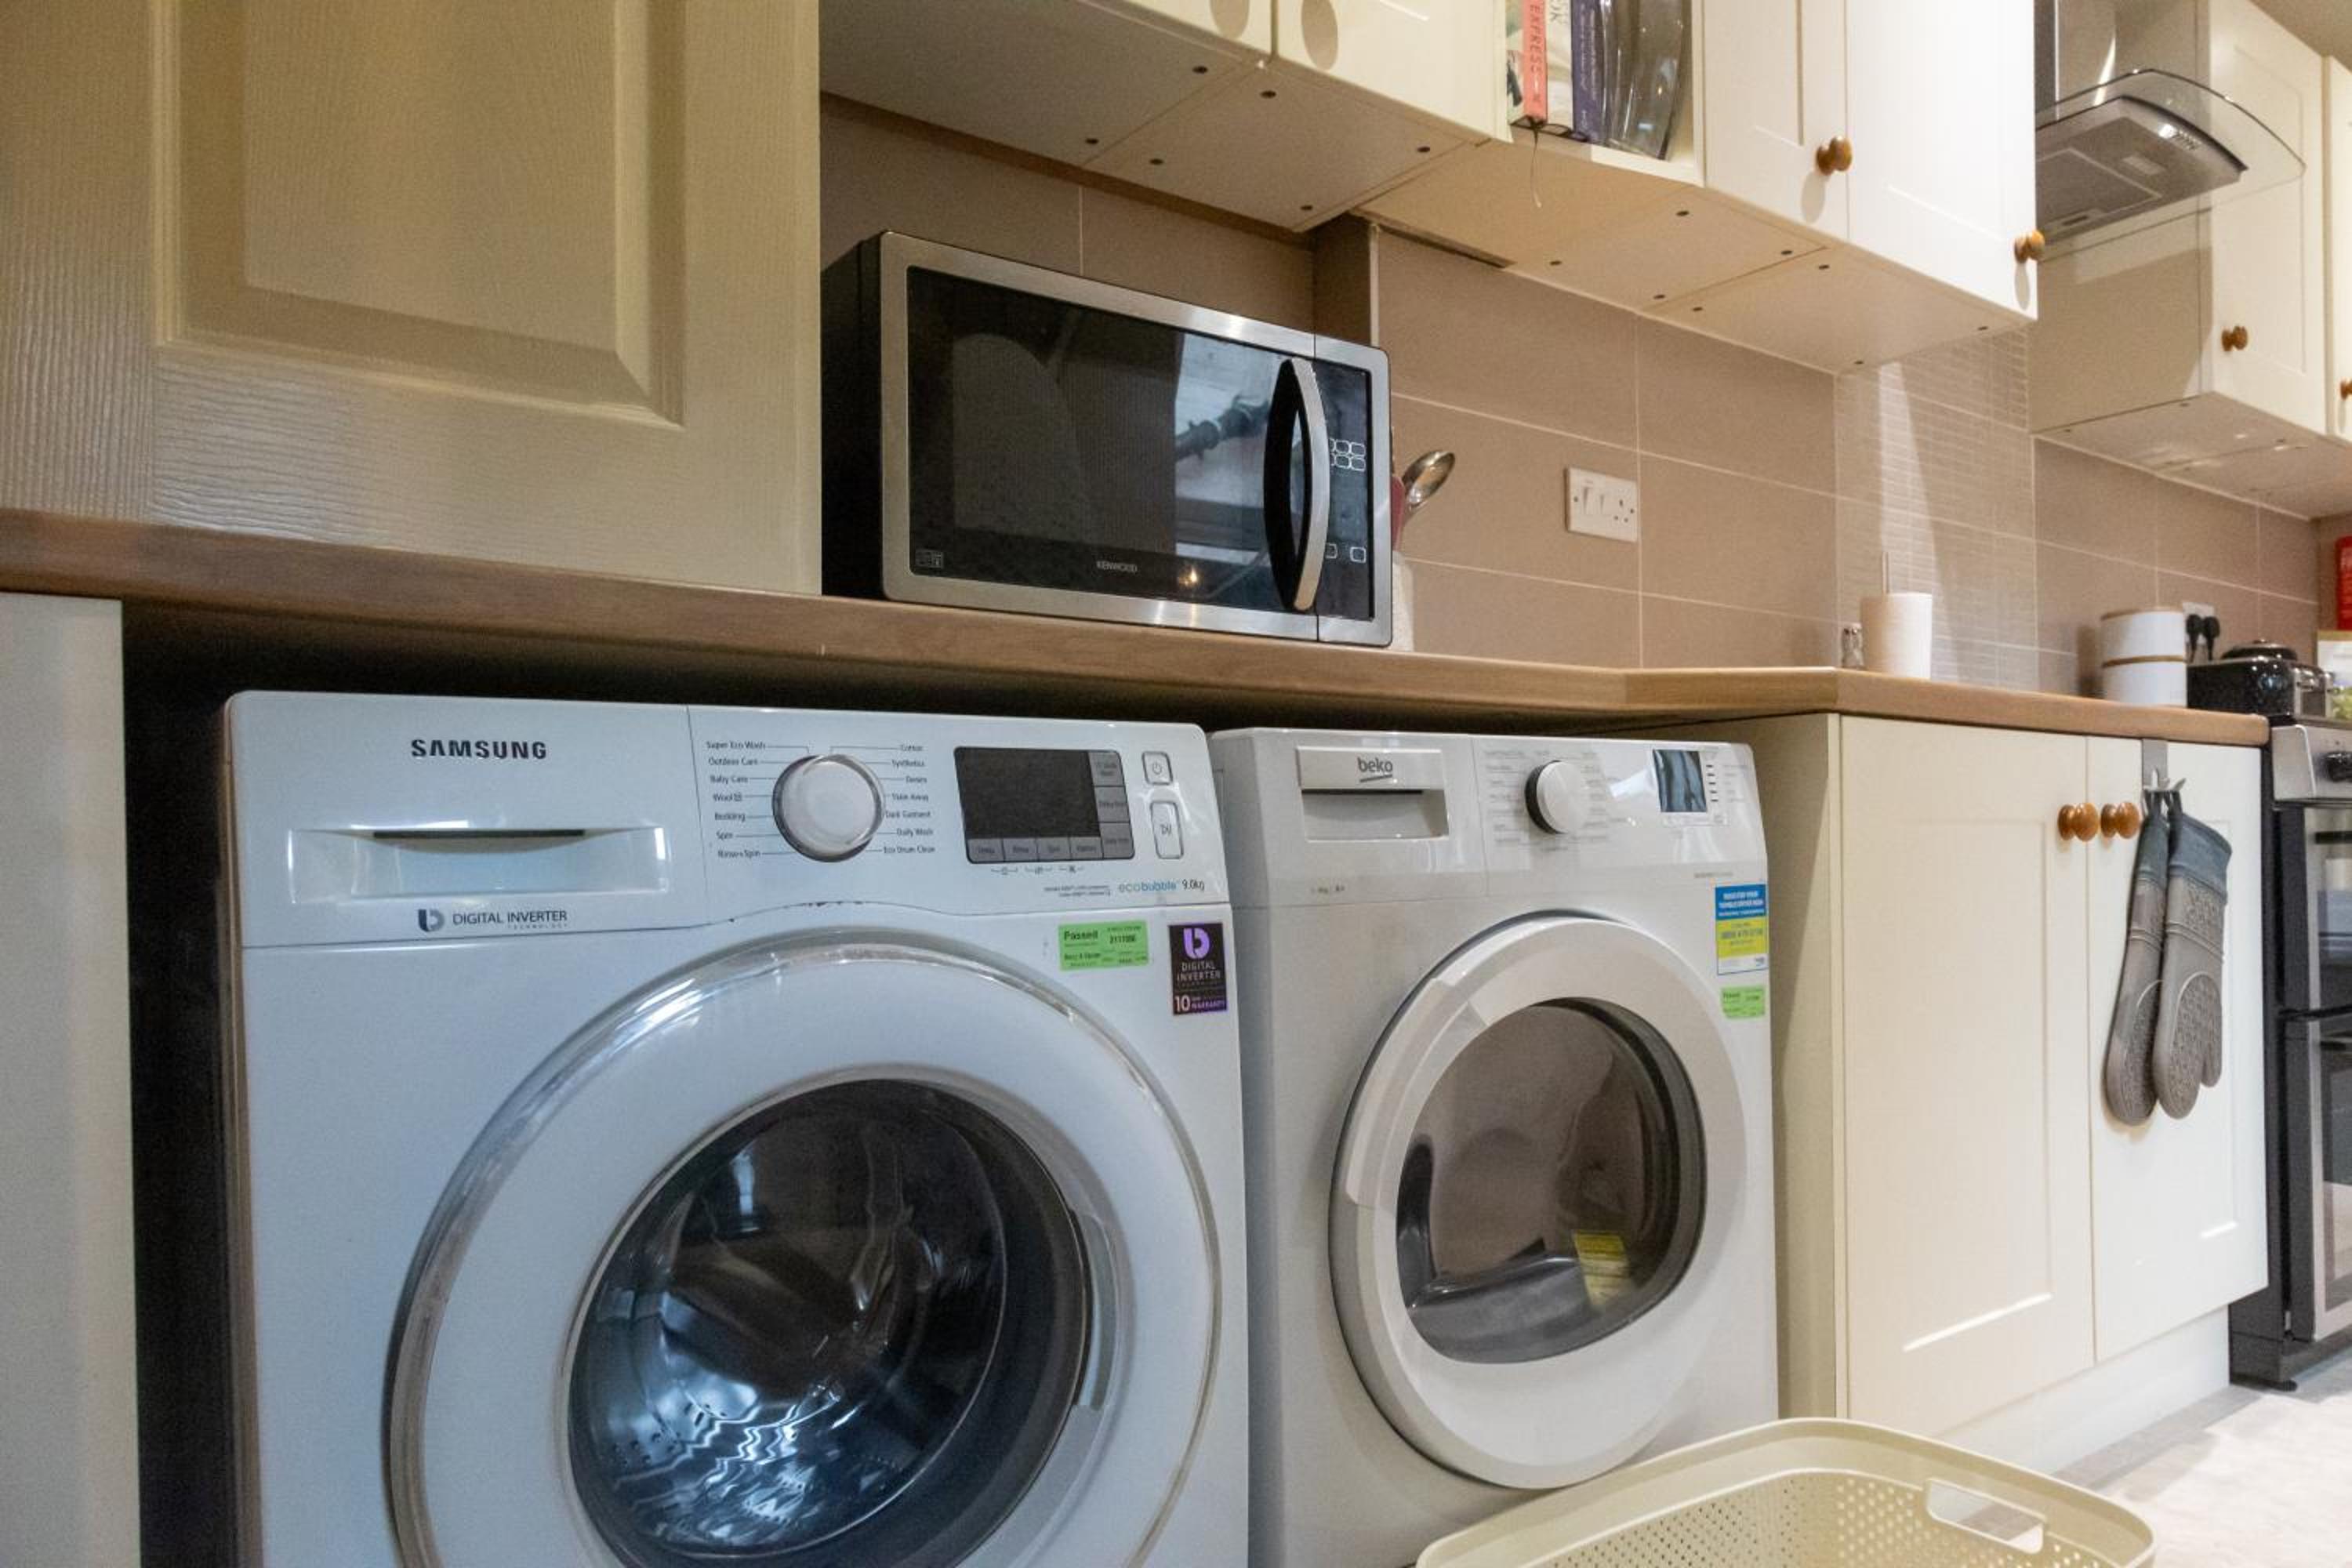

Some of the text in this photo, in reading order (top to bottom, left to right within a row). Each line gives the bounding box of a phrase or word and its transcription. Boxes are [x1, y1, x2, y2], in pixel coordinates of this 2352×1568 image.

[1096, 560, 1138, 573] KENWOOD
[411, 739, 546, 759] SAMSUNG
[1357, 757, 1393, 773] beko
[1119, 880, 1177, 892] ecobubble
[1181, 879, 1205, 891] 9.0kg
[452, 910, 568, 926] DIGITAL INVERTER
[1181, 961, 1217, 972] DIGITAL
[1177, 970, 1221, 982] INVERTER
[1175, 995, 1191, 1012] 10
